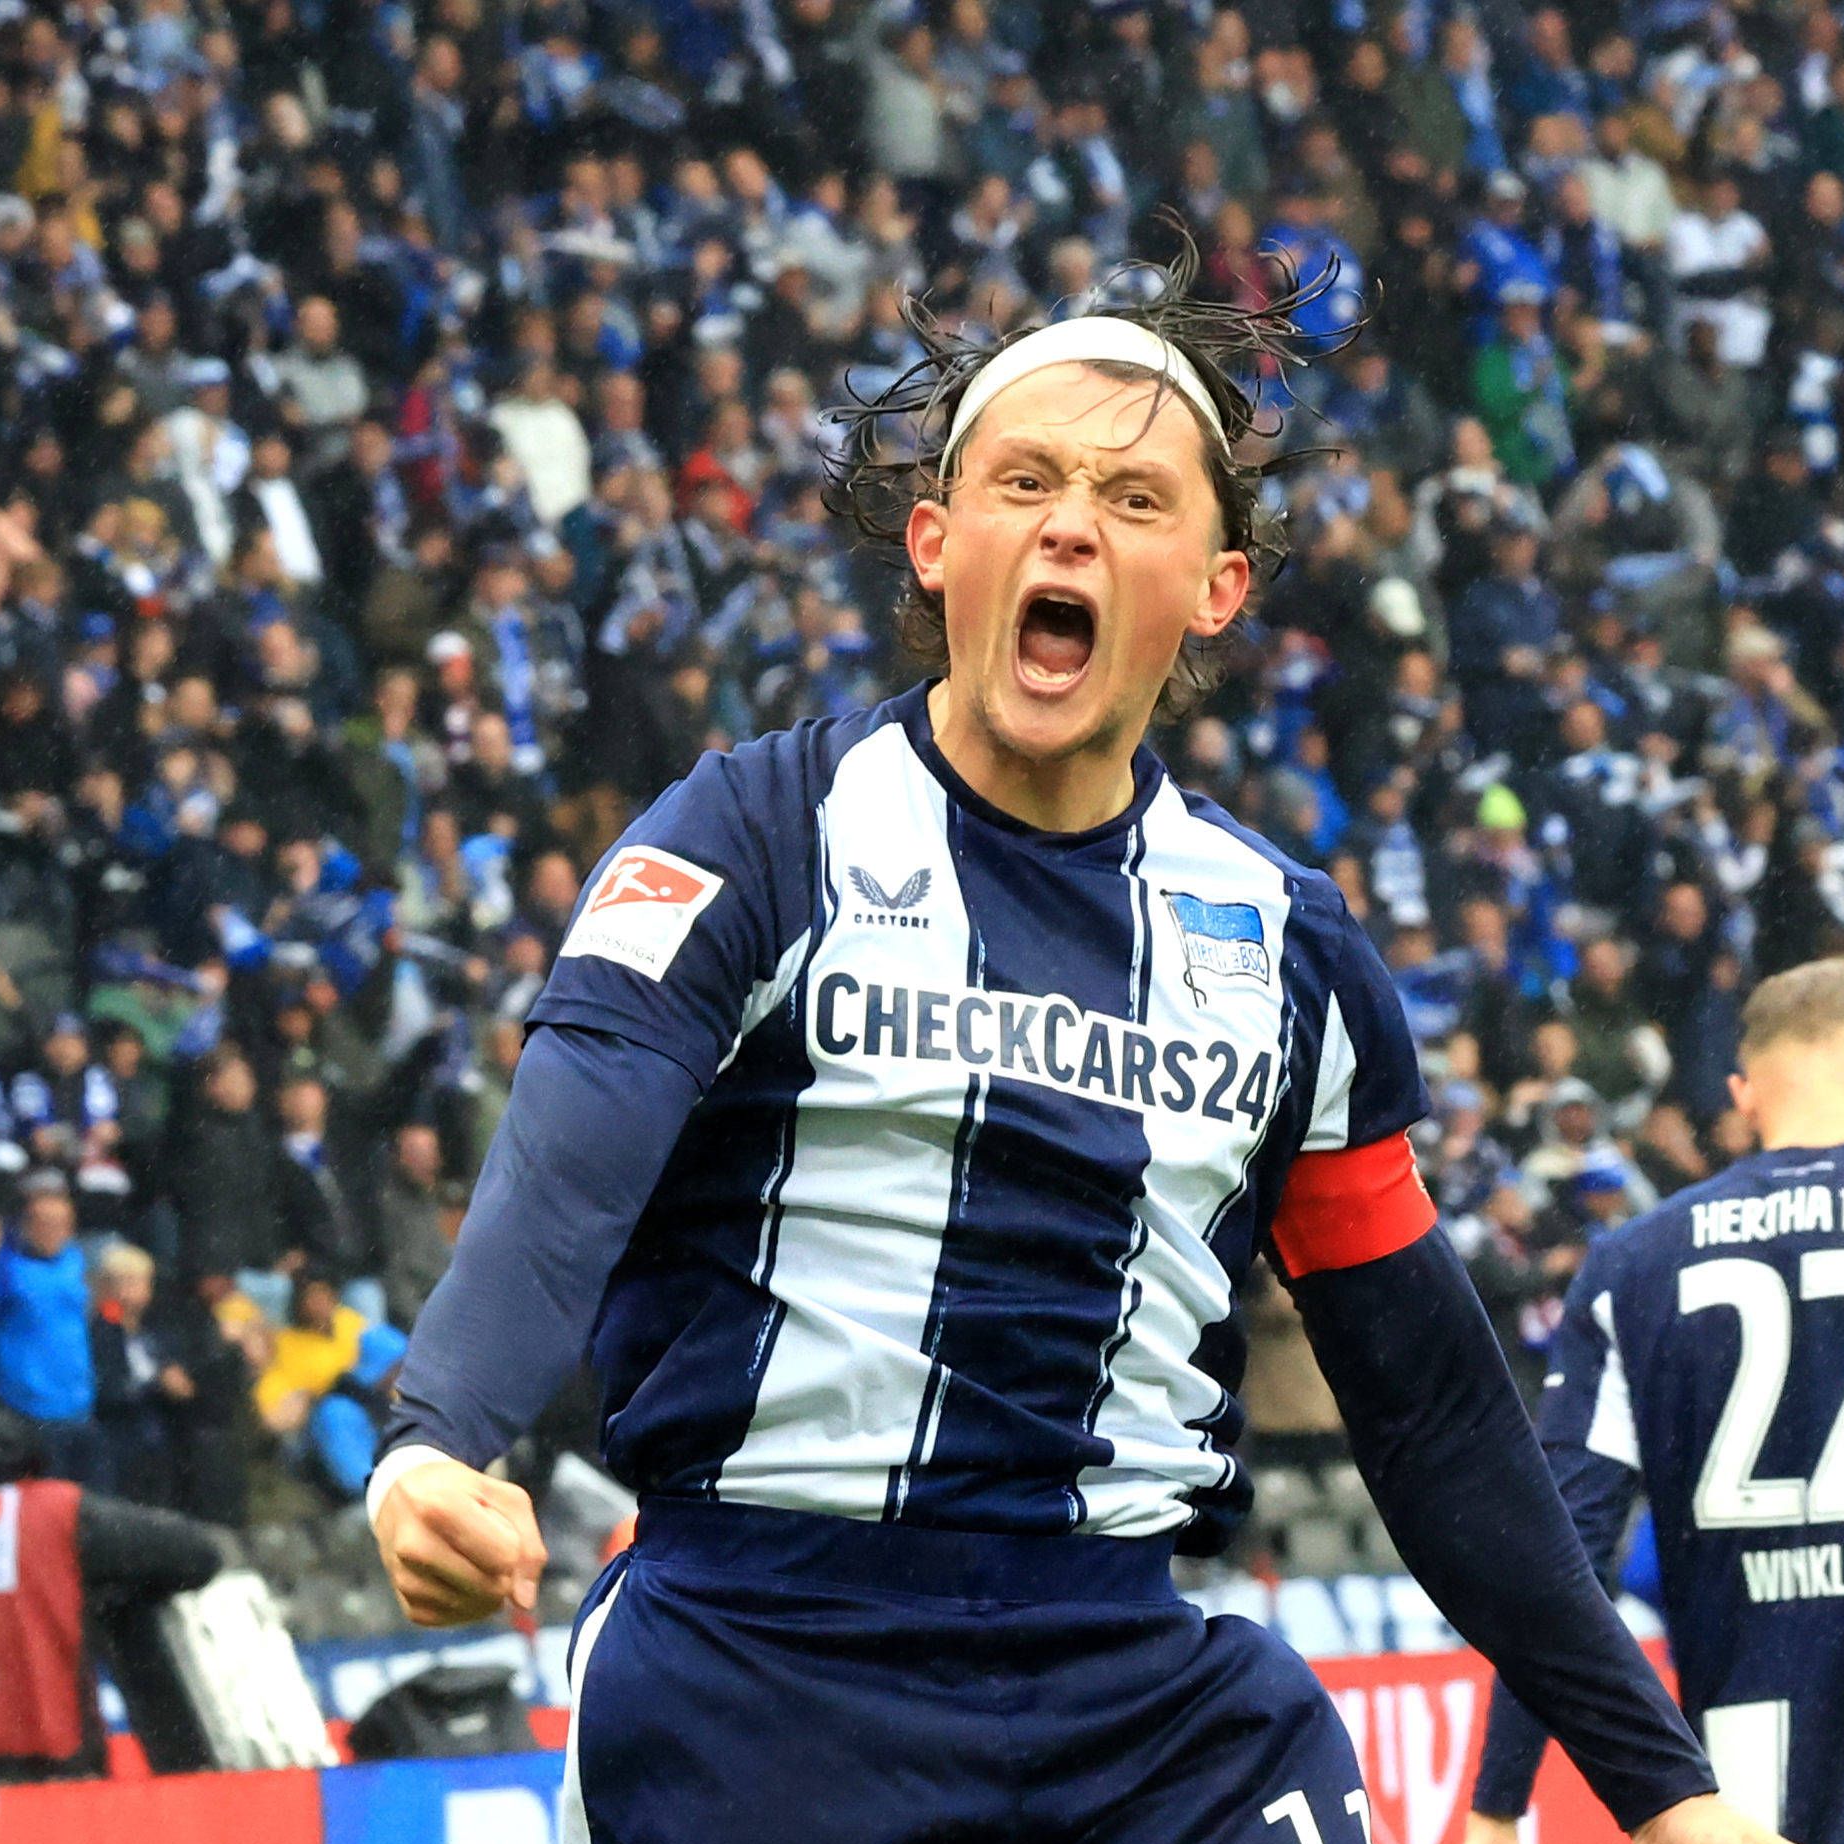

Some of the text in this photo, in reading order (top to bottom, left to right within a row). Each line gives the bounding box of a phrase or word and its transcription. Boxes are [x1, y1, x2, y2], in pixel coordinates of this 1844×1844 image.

[854, 913, 930, 930] CASTORE
[815, 971, 1273, 1132] CHECKCARS24
[1690, 1185, 1834, 1249] HERTHA
